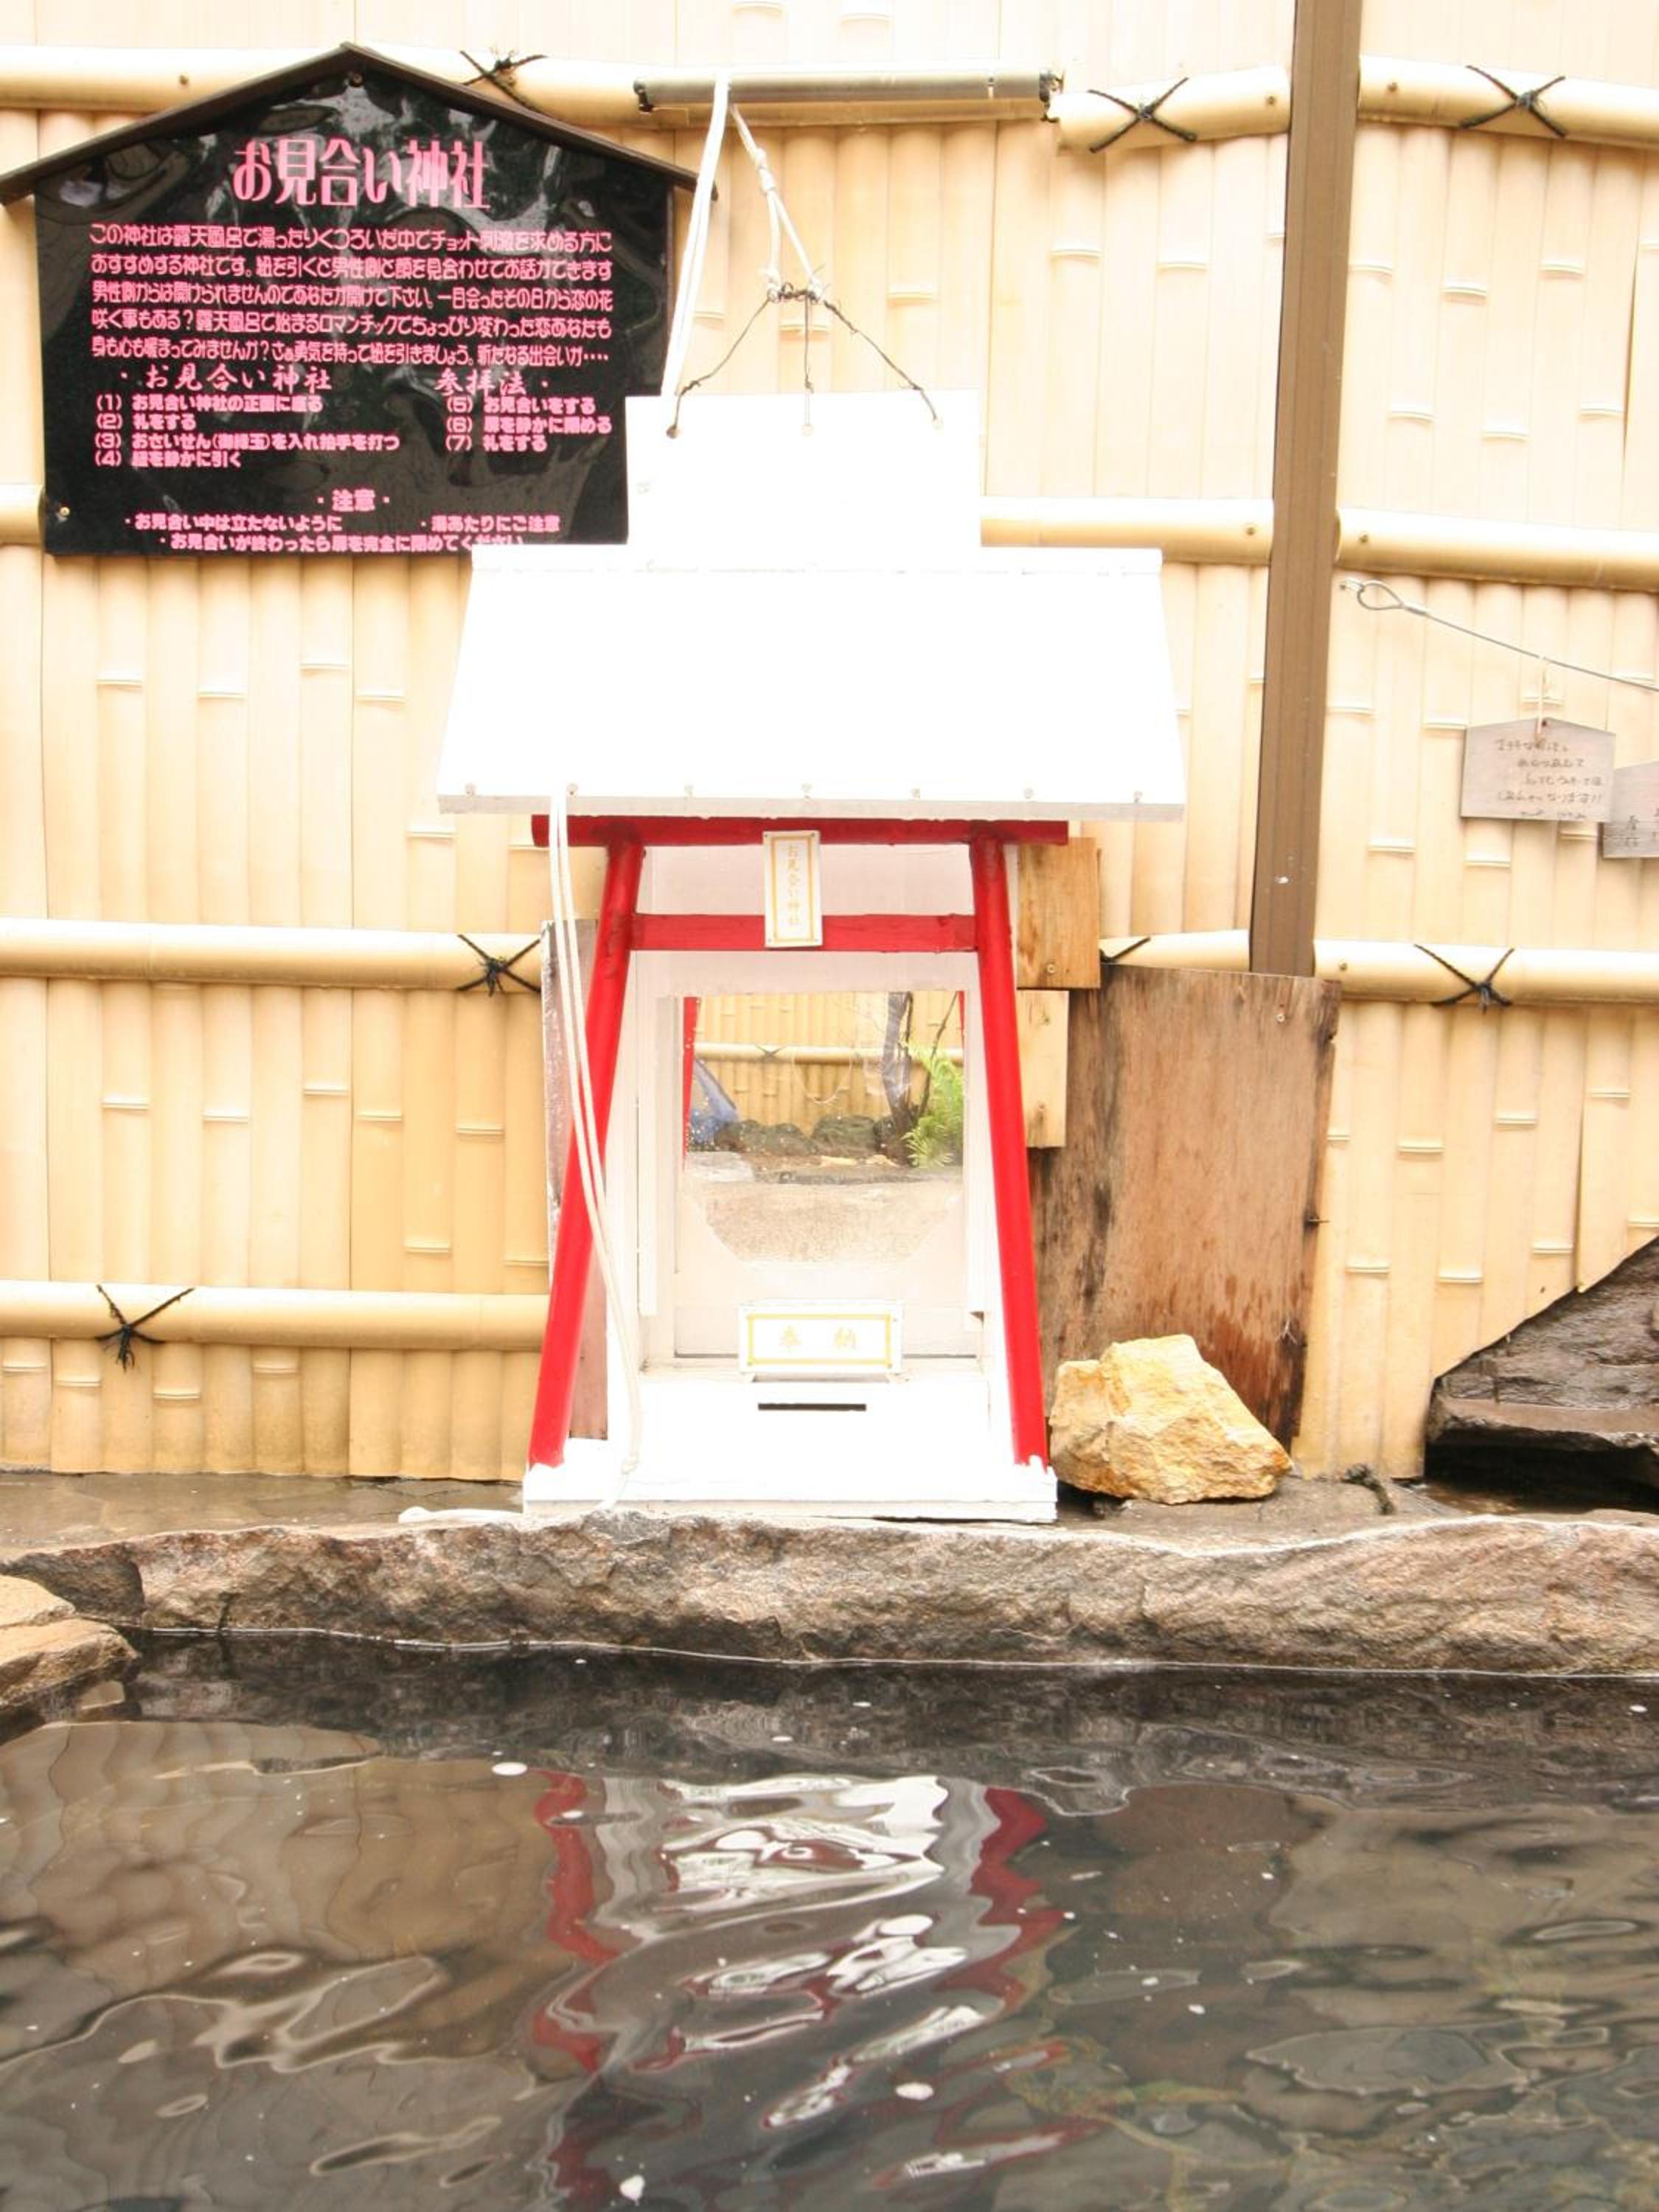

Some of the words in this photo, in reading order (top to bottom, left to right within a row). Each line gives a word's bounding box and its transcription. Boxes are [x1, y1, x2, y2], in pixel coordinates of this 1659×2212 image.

[232, 139, 490, 209] お見合い神社
[484, 397, 597, 414] お見合いをする
